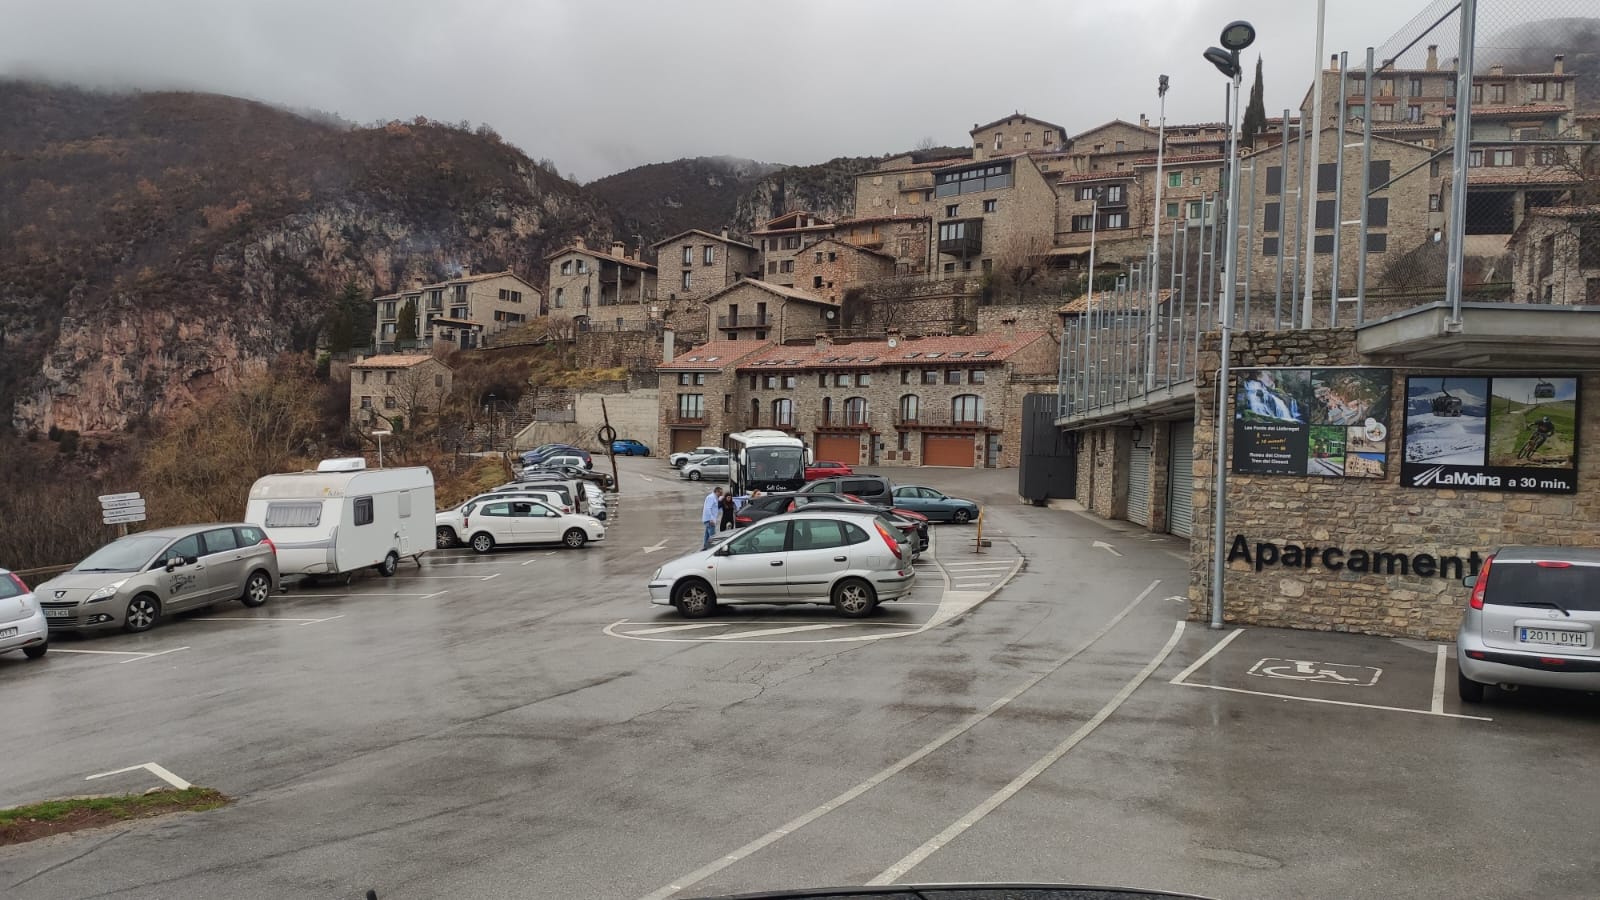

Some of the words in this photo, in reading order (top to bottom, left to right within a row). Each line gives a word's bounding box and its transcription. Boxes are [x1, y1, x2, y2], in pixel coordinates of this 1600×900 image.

[1508, 479, 1517, 488] a
[1520, 477, 1537, 489] 30
[1540, 478, 1571, 489] min.
[1227, 534, 1483, 579] Aparcament
[1529, 630, 1556, 641] 2011
[1561, 632, 1583, 643] DYH
